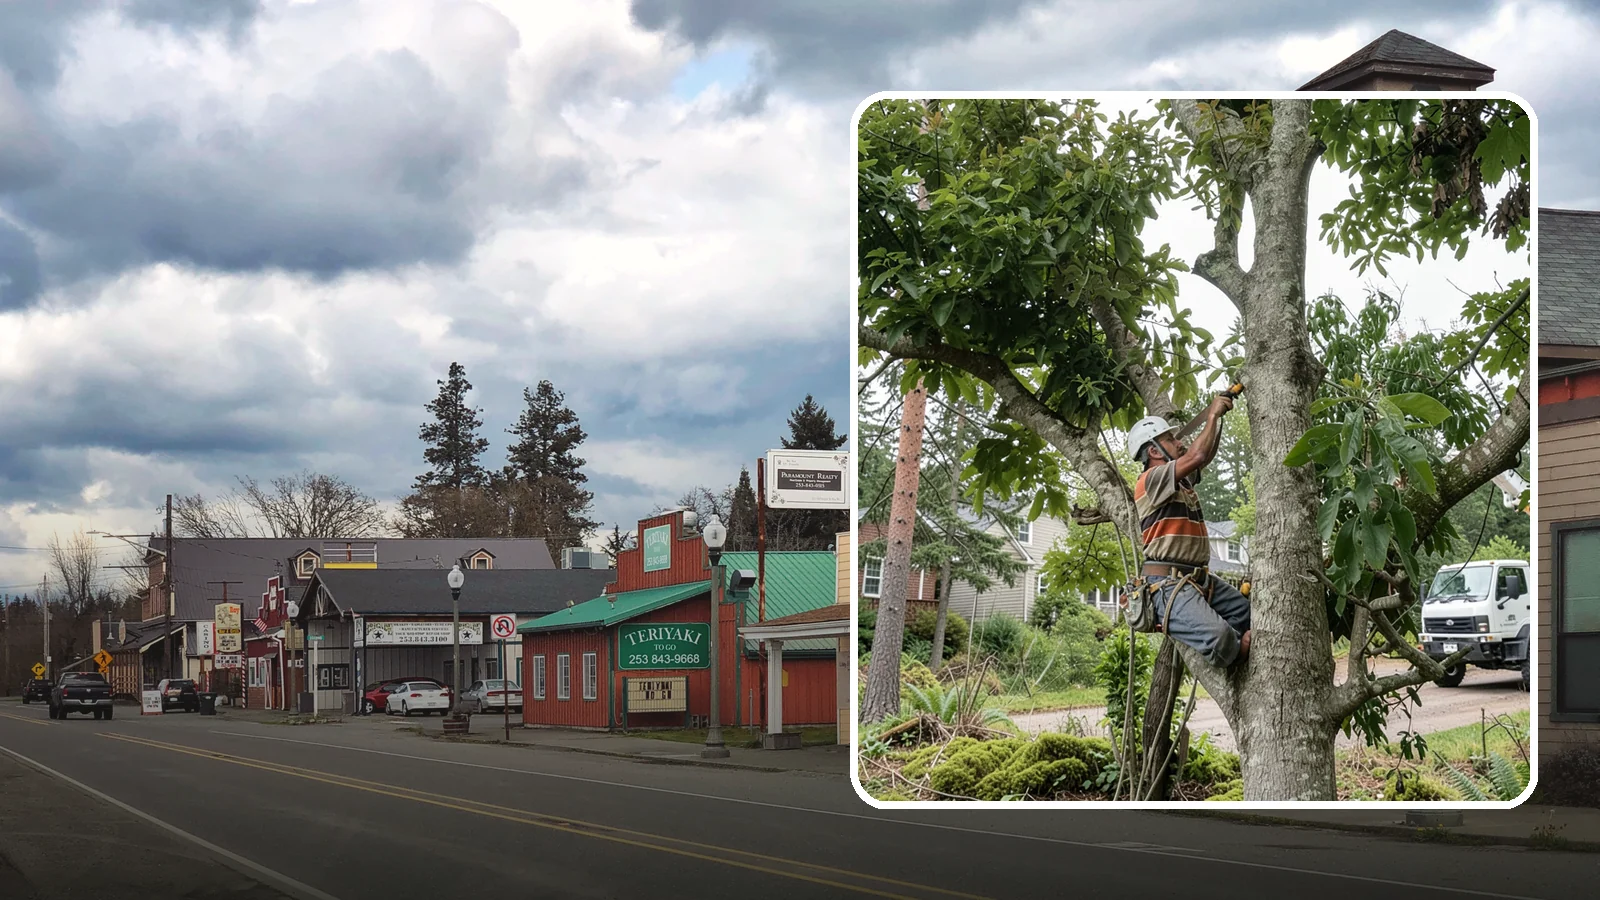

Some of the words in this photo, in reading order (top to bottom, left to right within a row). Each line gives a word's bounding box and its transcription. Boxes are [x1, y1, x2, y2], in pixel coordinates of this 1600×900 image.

[781, 471, 815, 479] PARAMOUNT
[817, 472, 839, 480] REALTY
[625, 627, 702, 646] TERIYAKI
[628, 654, 649, 665] 253
[651, 653, 700, 664] 843-9668
[639, 681, 673, 691] TERIYAKI
